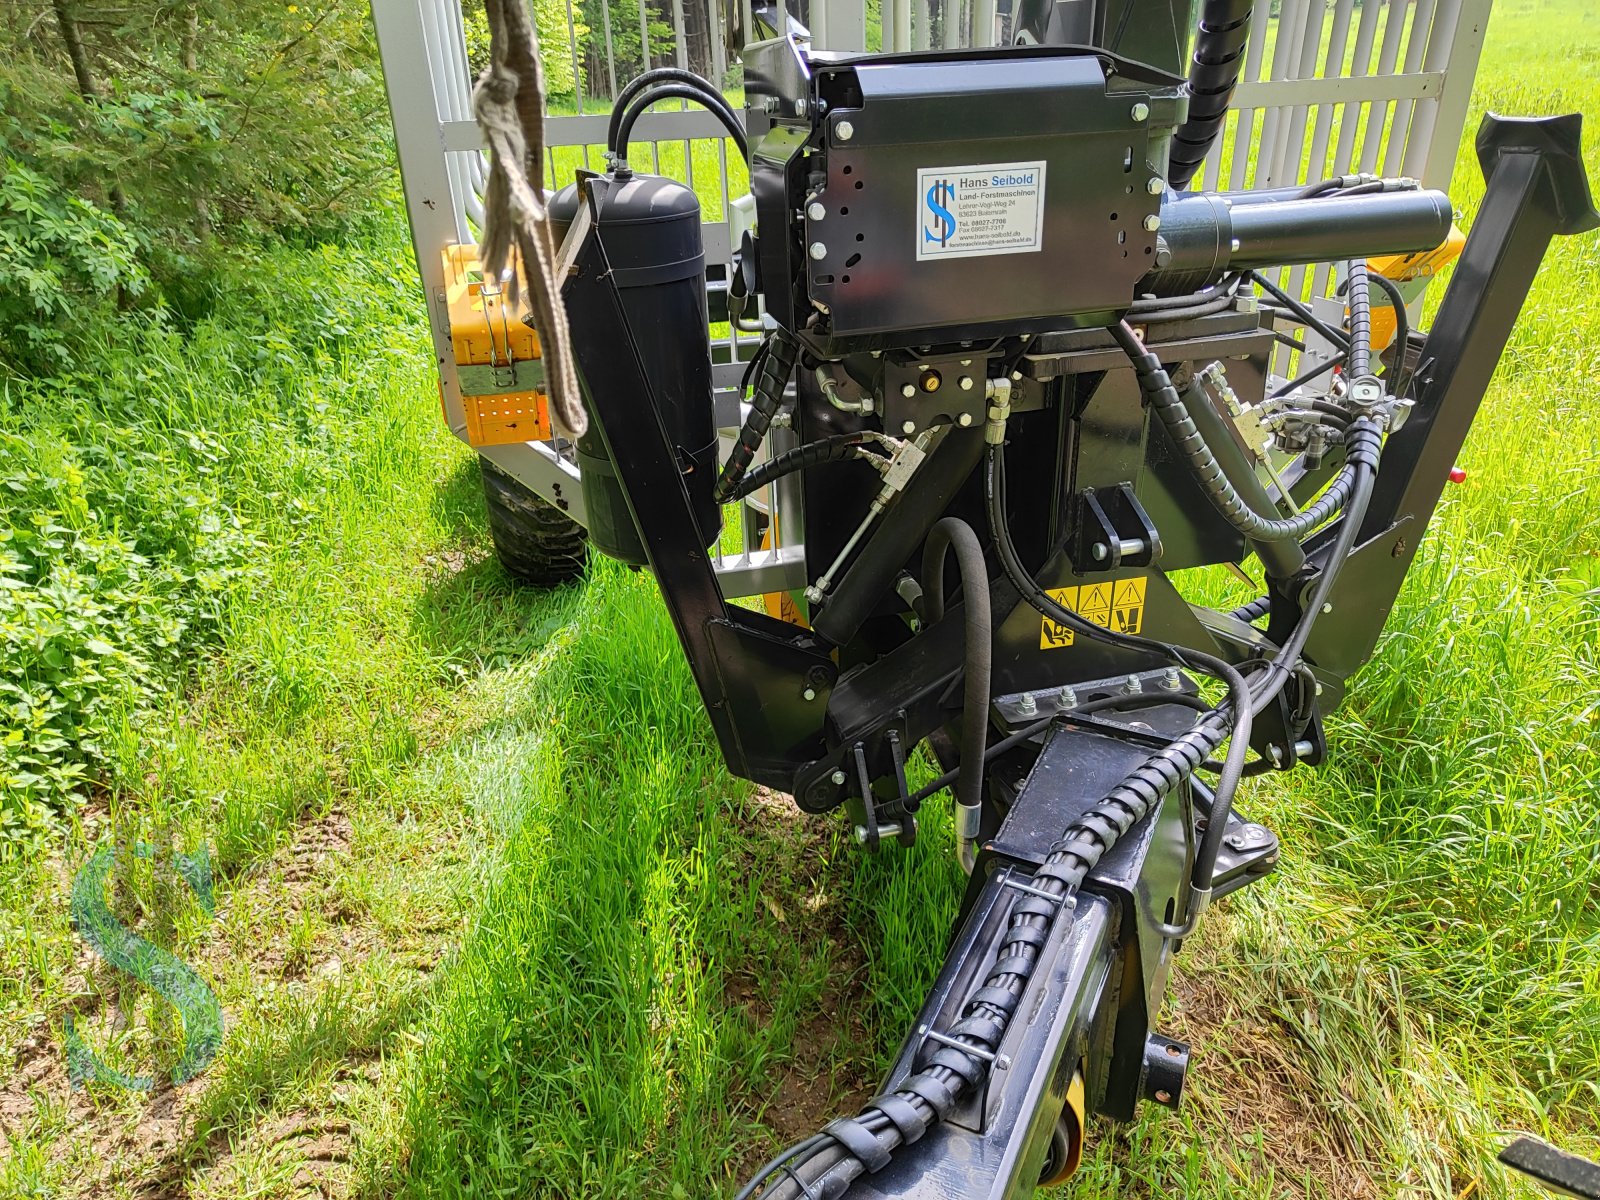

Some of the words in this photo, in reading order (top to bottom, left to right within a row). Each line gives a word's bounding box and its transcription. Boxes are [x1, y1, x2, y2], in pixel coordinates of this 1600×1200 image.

[960, 178, 988, 188] Hans
[992, 174, 1034, 187] Seibold
[959, 193, 979, 201] Land-
[980, 190, 1036, 200] Forstmaschinen
